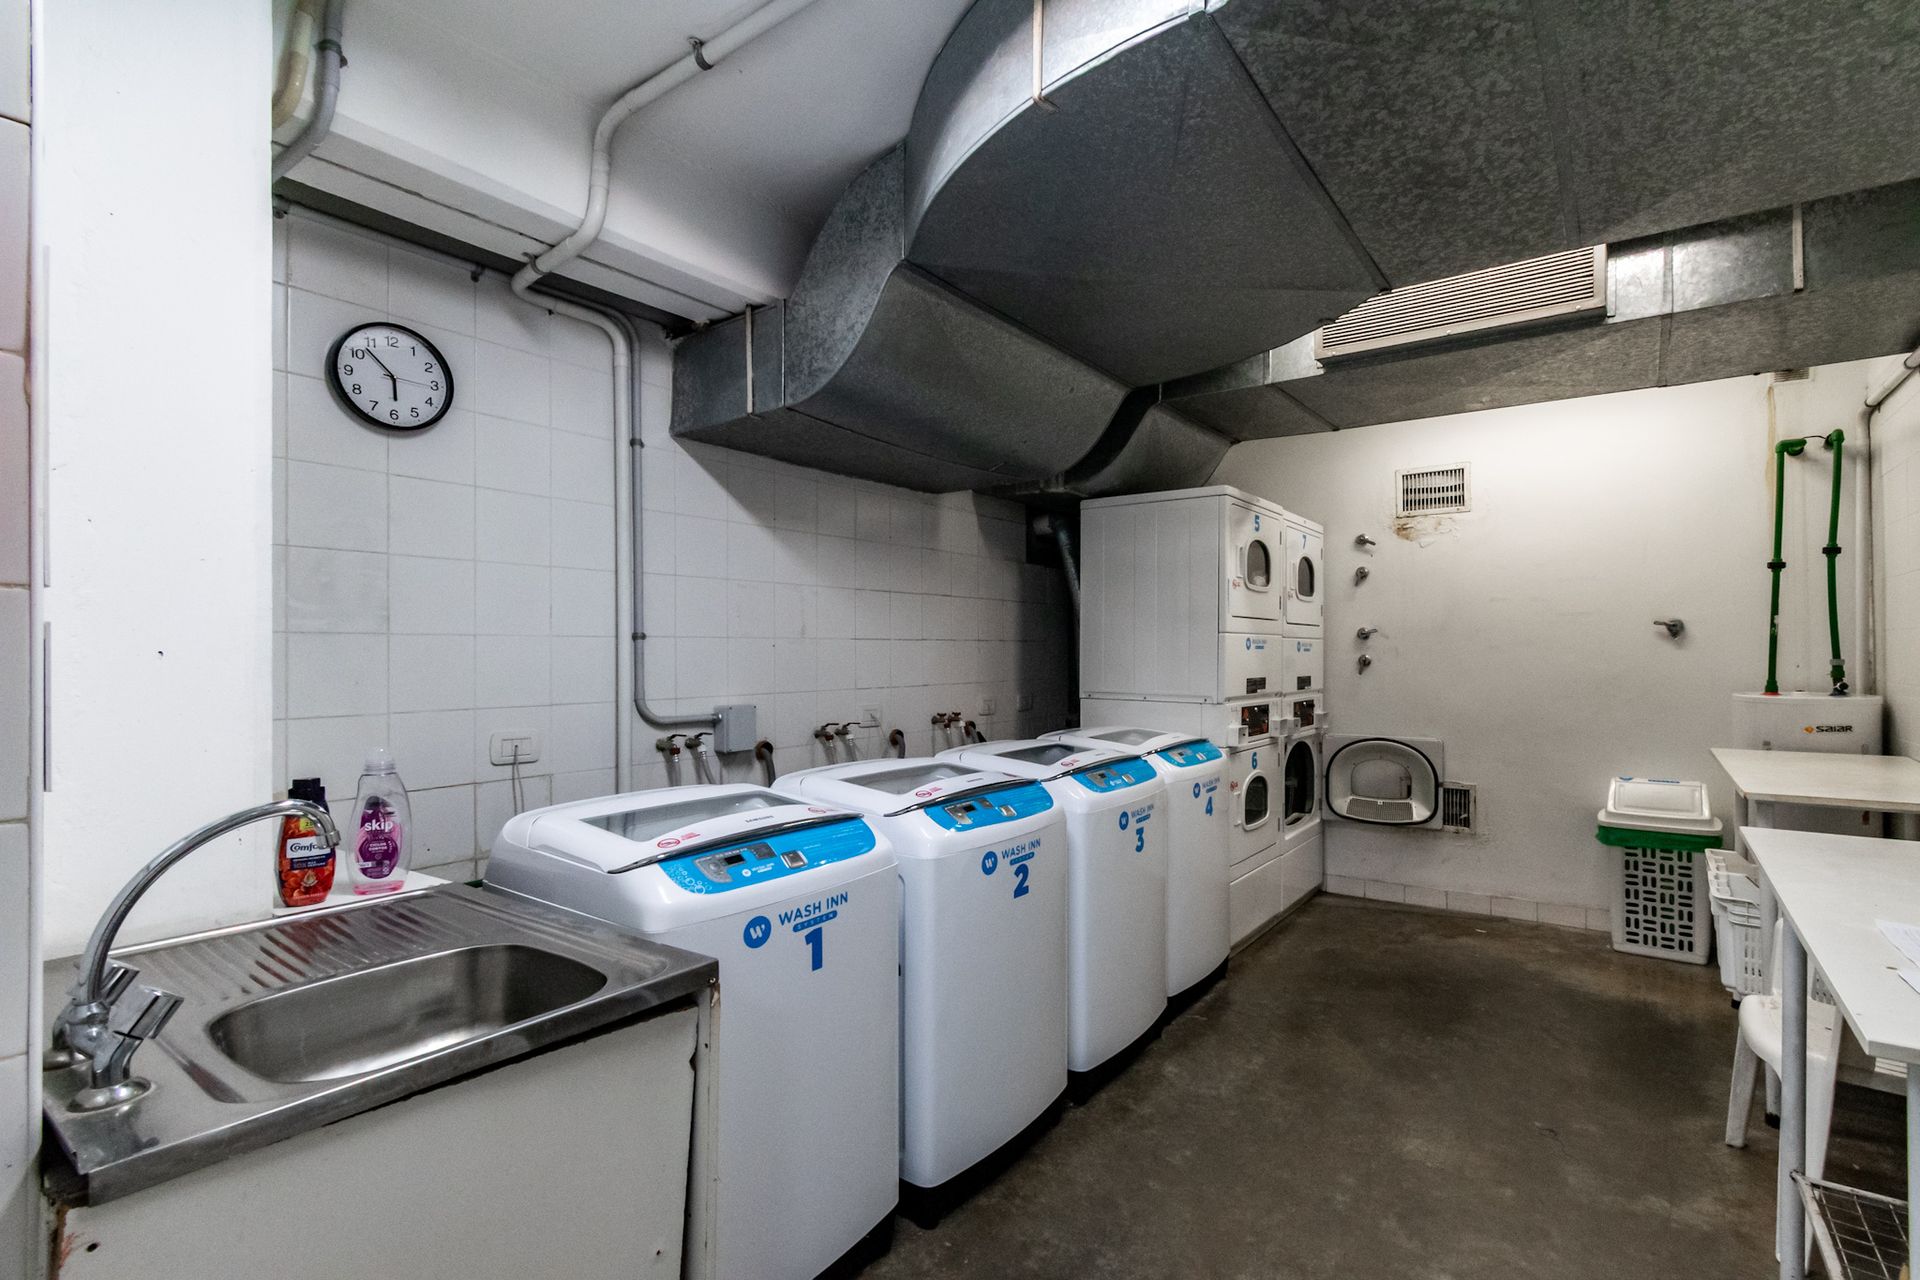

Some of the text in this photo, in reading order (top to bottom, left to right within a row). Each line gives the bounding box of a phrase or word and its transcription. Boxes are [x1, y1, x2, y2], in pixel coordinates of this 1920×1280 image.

[364, 337, 376, 348] 11
[384, 335, 399, 348] 12
[350, 347, 365, 360] 10
[410, 346, 415, 357] 1
[343, 364, 354, 376] 9
[424, 362, 433, 373] 2
[352, 383, 362, 395] 8
[430, 380, 439, 391] 3
[369, 399, 379, 411] 7
[425, 396, 433, 407] 4
[389, 409, 399, 421] 6
[410, 407, 419, 418] 5
[1254, 514, 1260, 532] 5
[1302, 534, 1307, 549] 7
[1251, 751, 1258, 770] 6
[1131, 807, 1146, 818] WASH
[1205, 796, 1213, 816] 4
[364, 819, 394, 833] skip
[1135, 826, 1145, 853] 3
[1001, 844, 1026, 860] WASH
[1028, 837, 1041, 850] INN
[1013, 863, 1029, 899] 2
[778, 900, 821, 926] WASH
[826, 891, 848, 910] INN
[804, 926, 823, 972] 1
